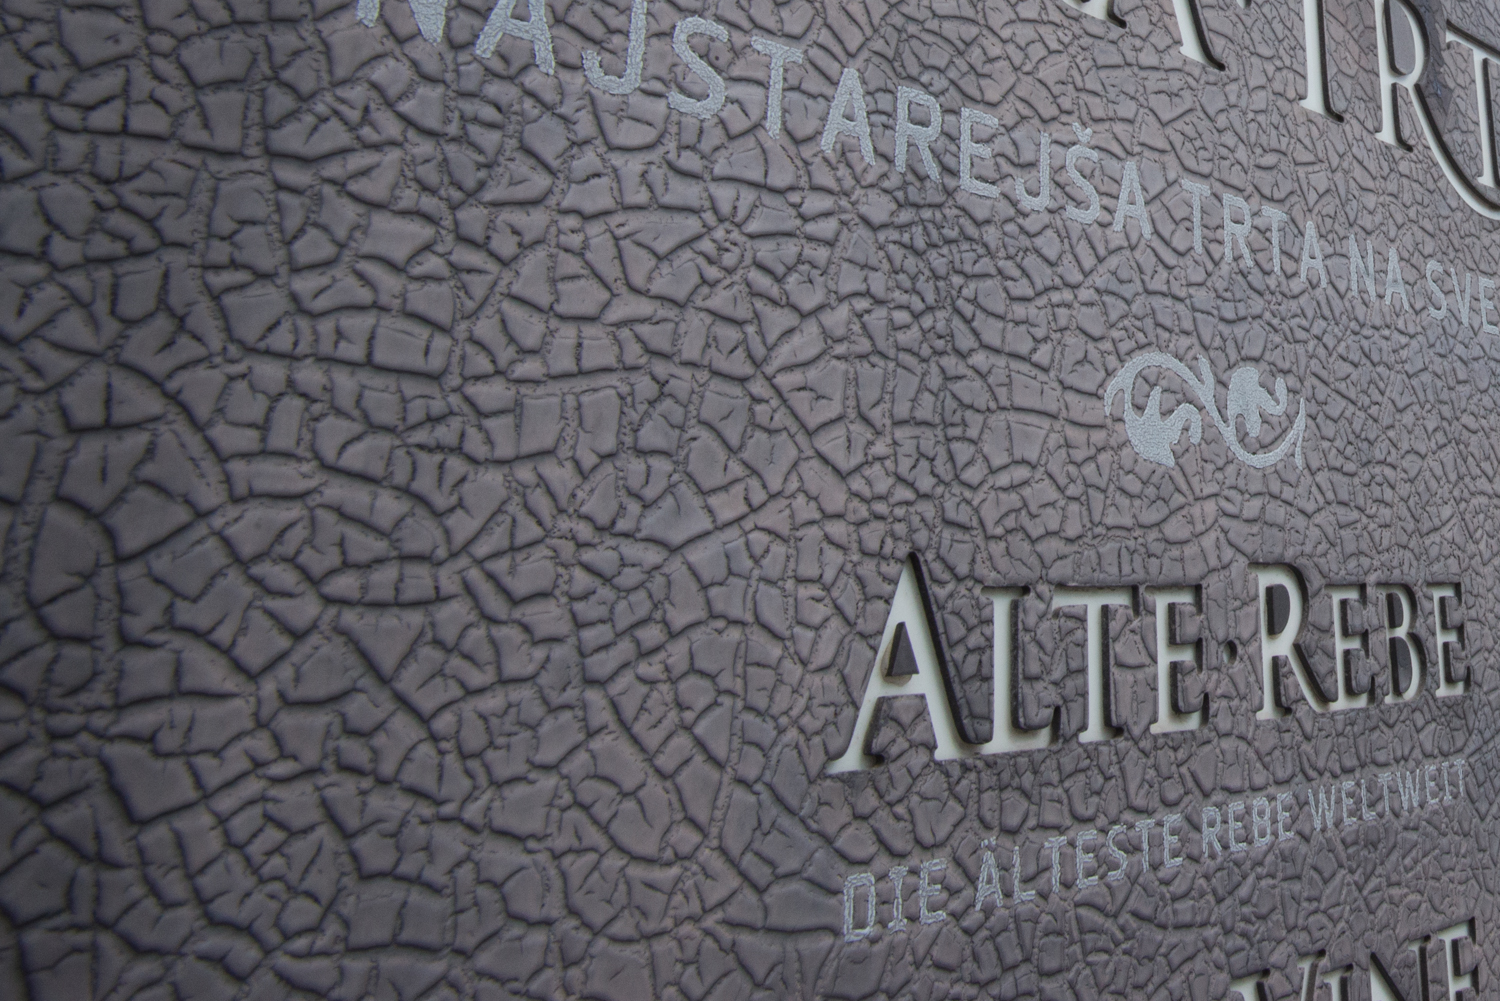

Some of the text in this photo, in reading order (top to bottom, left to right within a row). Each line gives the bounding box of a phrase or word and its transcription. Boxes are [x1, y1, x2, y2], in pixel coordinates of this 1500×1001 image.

[1181, 178, 1328, 289] TRTA
[1349, 234, 1409, 312] NA
[826, 551, 1472, 774] ALTE REBE
[843, 758, 1468, 943] DIE ÄLTESTE REBE WELTWEIT
[1229, 916, 1480, 1001] NE
